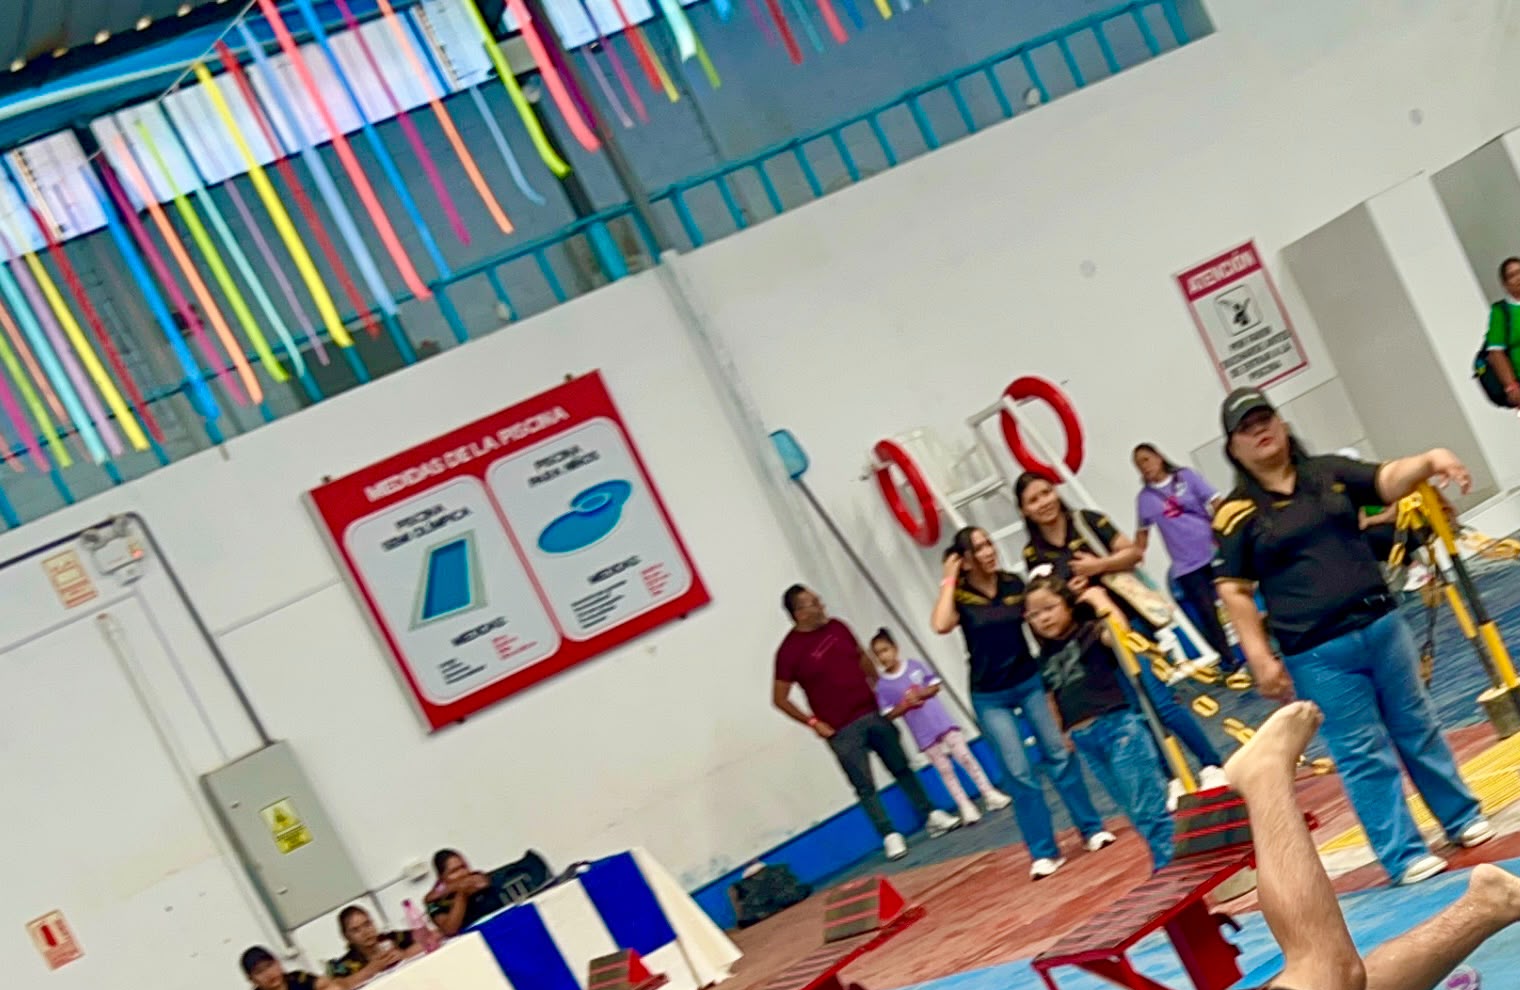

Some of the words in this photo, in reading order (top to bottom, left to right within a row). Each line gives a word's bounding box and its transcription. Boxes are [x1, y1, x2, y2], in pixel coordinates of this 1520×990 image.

[364, 457, 447, 503] MEDIDAS
[443, 445, 474, 469] DE
[466, 435, 500, 458] LA
[496, 405, 571, 446] PISCINA
